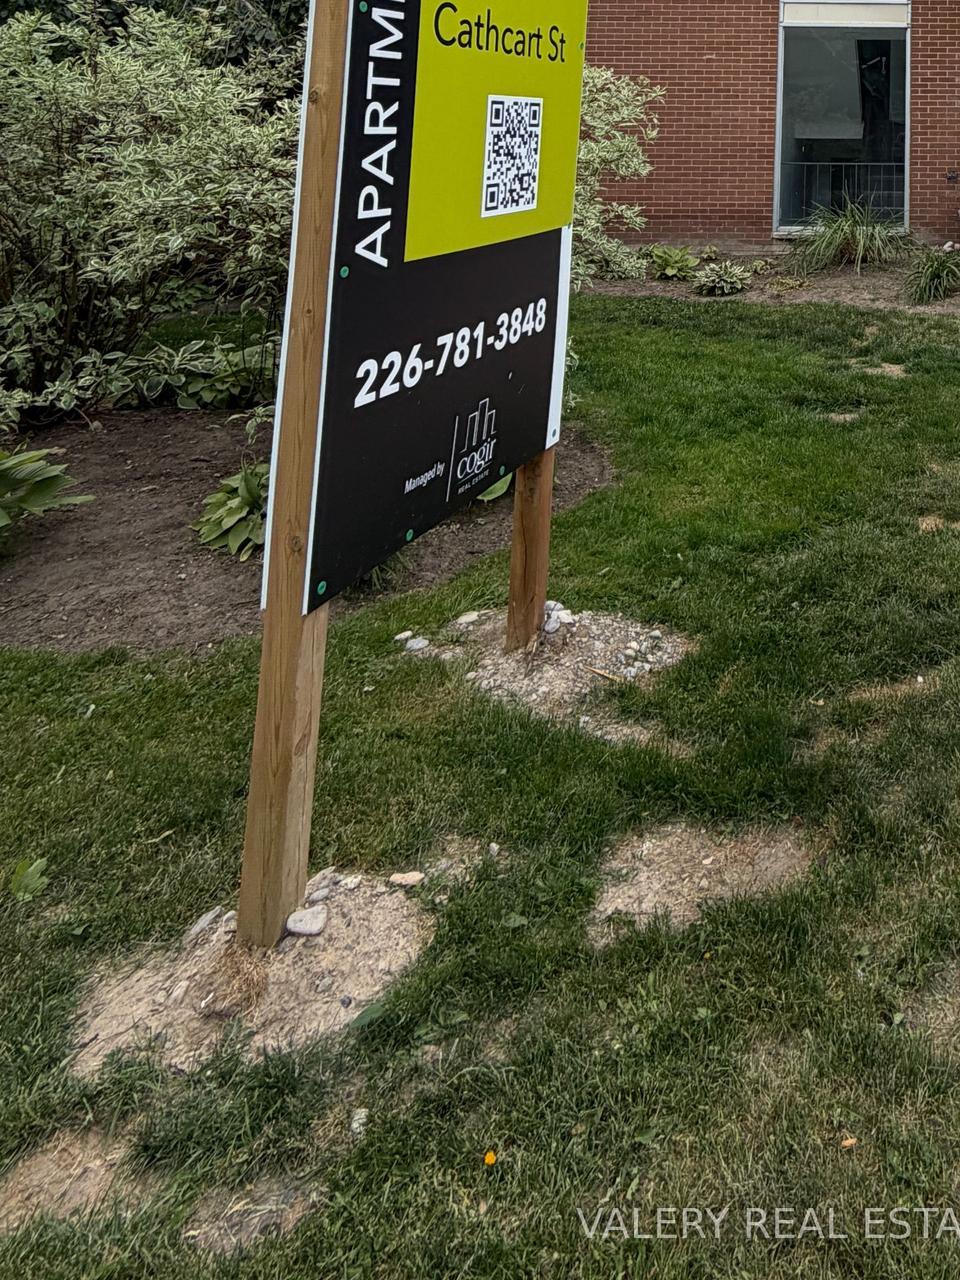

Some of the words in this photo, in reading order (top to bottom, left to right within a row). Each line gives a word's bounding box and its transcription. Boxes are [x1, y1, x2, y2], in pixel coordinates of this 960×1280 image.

[434, 1, 543, 59] Cathcart
[547, 25, 566, 63] St
[353, 297, 547, 408] 226-781-3848
[404, 463, 437, 495] Managed
[436, 461, 446, 477] by
[457, 438, 497, 479] cogir
